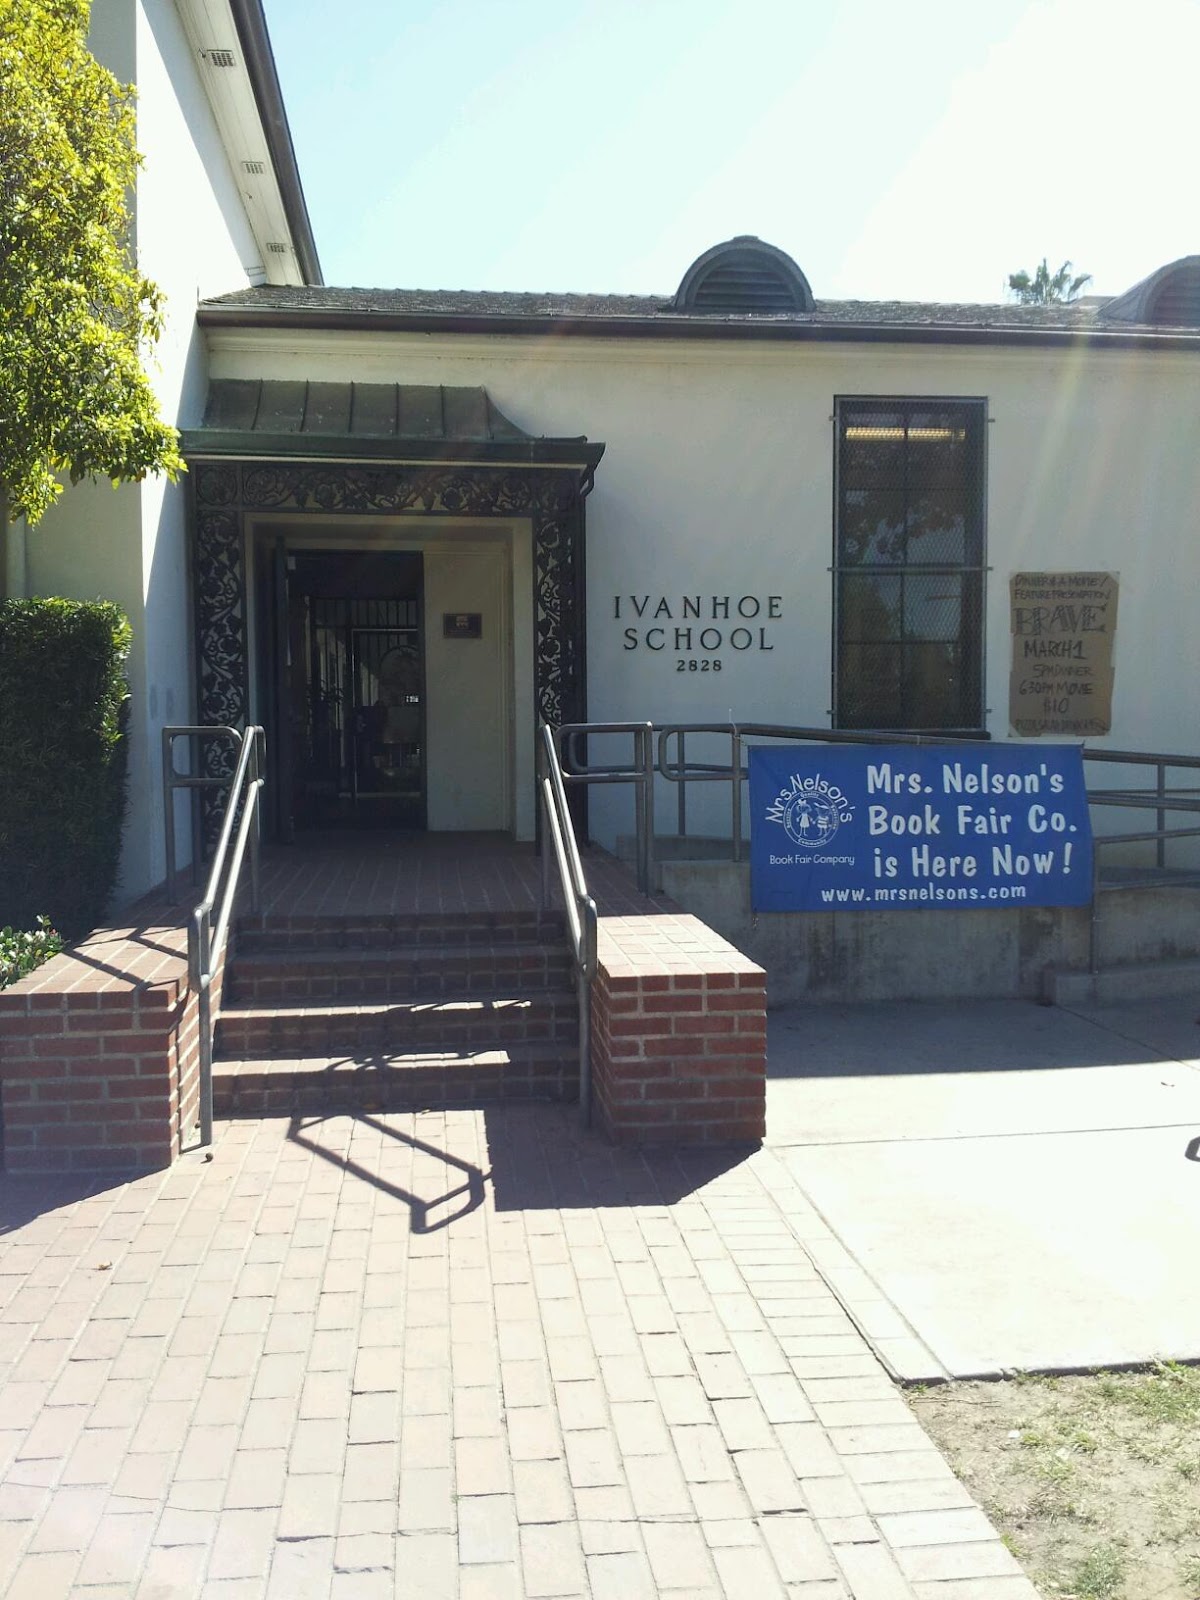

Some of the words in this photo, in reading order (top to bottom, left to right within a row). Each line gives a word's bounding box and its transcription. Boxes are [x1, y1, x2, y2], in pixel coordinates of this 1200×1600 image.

[613, 595, 783, 619] IVANHOE
[1012, 604, 1107, 636] BRAVE
[623, 627, 774, 651] SCHOOL
[1024, 640, 1073, 659] MARCH
[676, 659, 723, 672] 2828
[867, 763, 933, 794] Mrs.
[942, 762, 1064, 794] Nelson's
[868, 804, 941, 836] Book
[957, 804, 1013, 836] Fair
[1028, 804, 1078, 834] Co.
[769, 854, 793, 865] Book
[795, 854, 812, 864] Fair
[813, 854, 856, 866] Company
[874, 847, 898, 878] is
[911, 844, 978, 878] Here
[820, 882, 1027, 903] www.mrsnelsons.com
